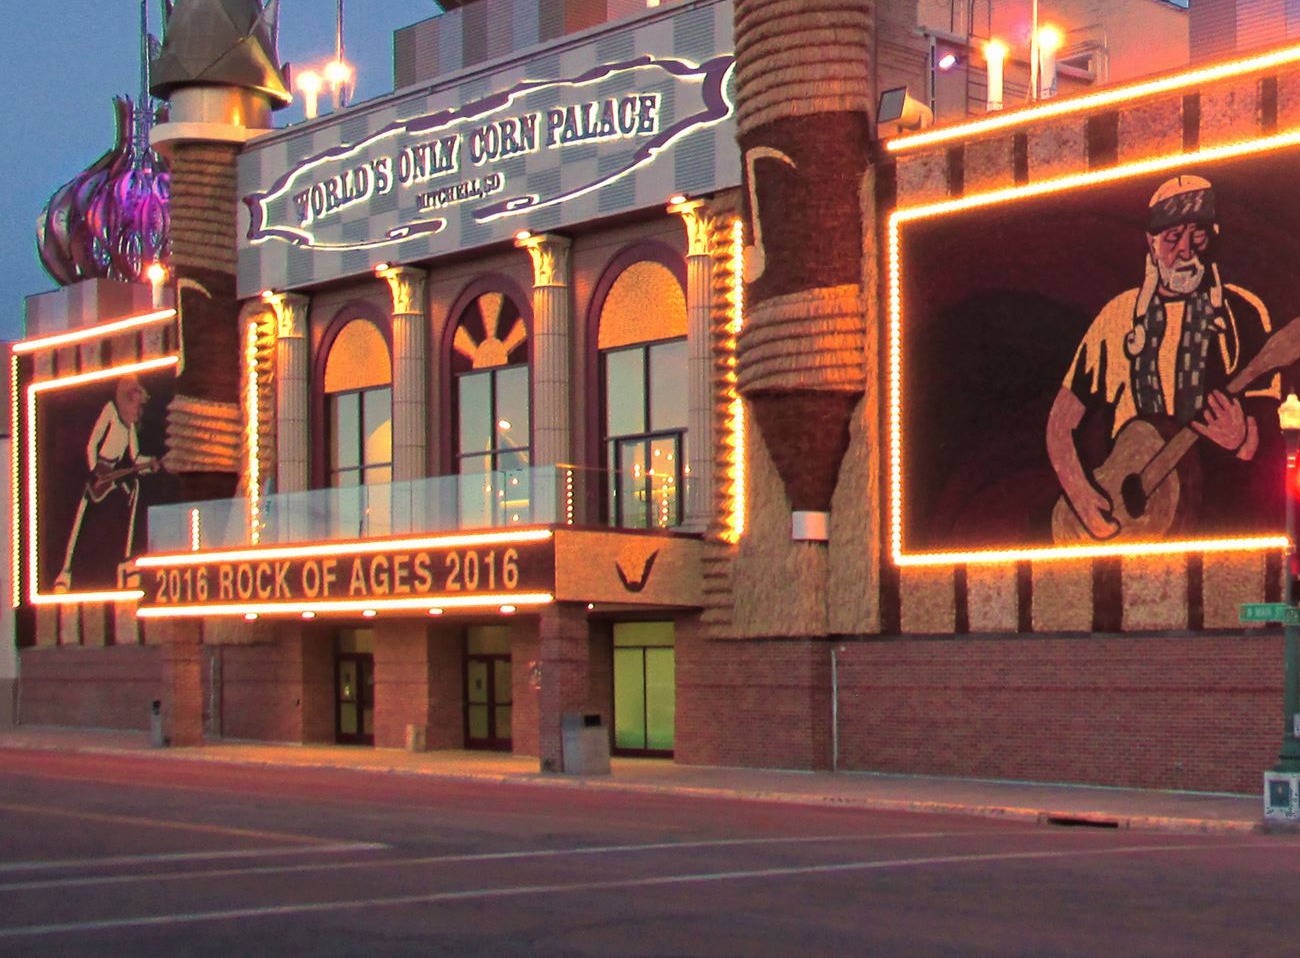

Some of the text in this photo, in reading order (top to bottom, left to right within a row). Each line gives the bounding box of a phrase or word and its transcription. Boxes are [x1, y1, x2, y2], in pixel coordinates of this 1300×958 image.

[293, 94, 660, 226] WORLD'S ONLY CORN PALACE
[483, 172, 503, 193] SD
[155, 547, 519, 604] 2016 ROCK OF AGES 2016
